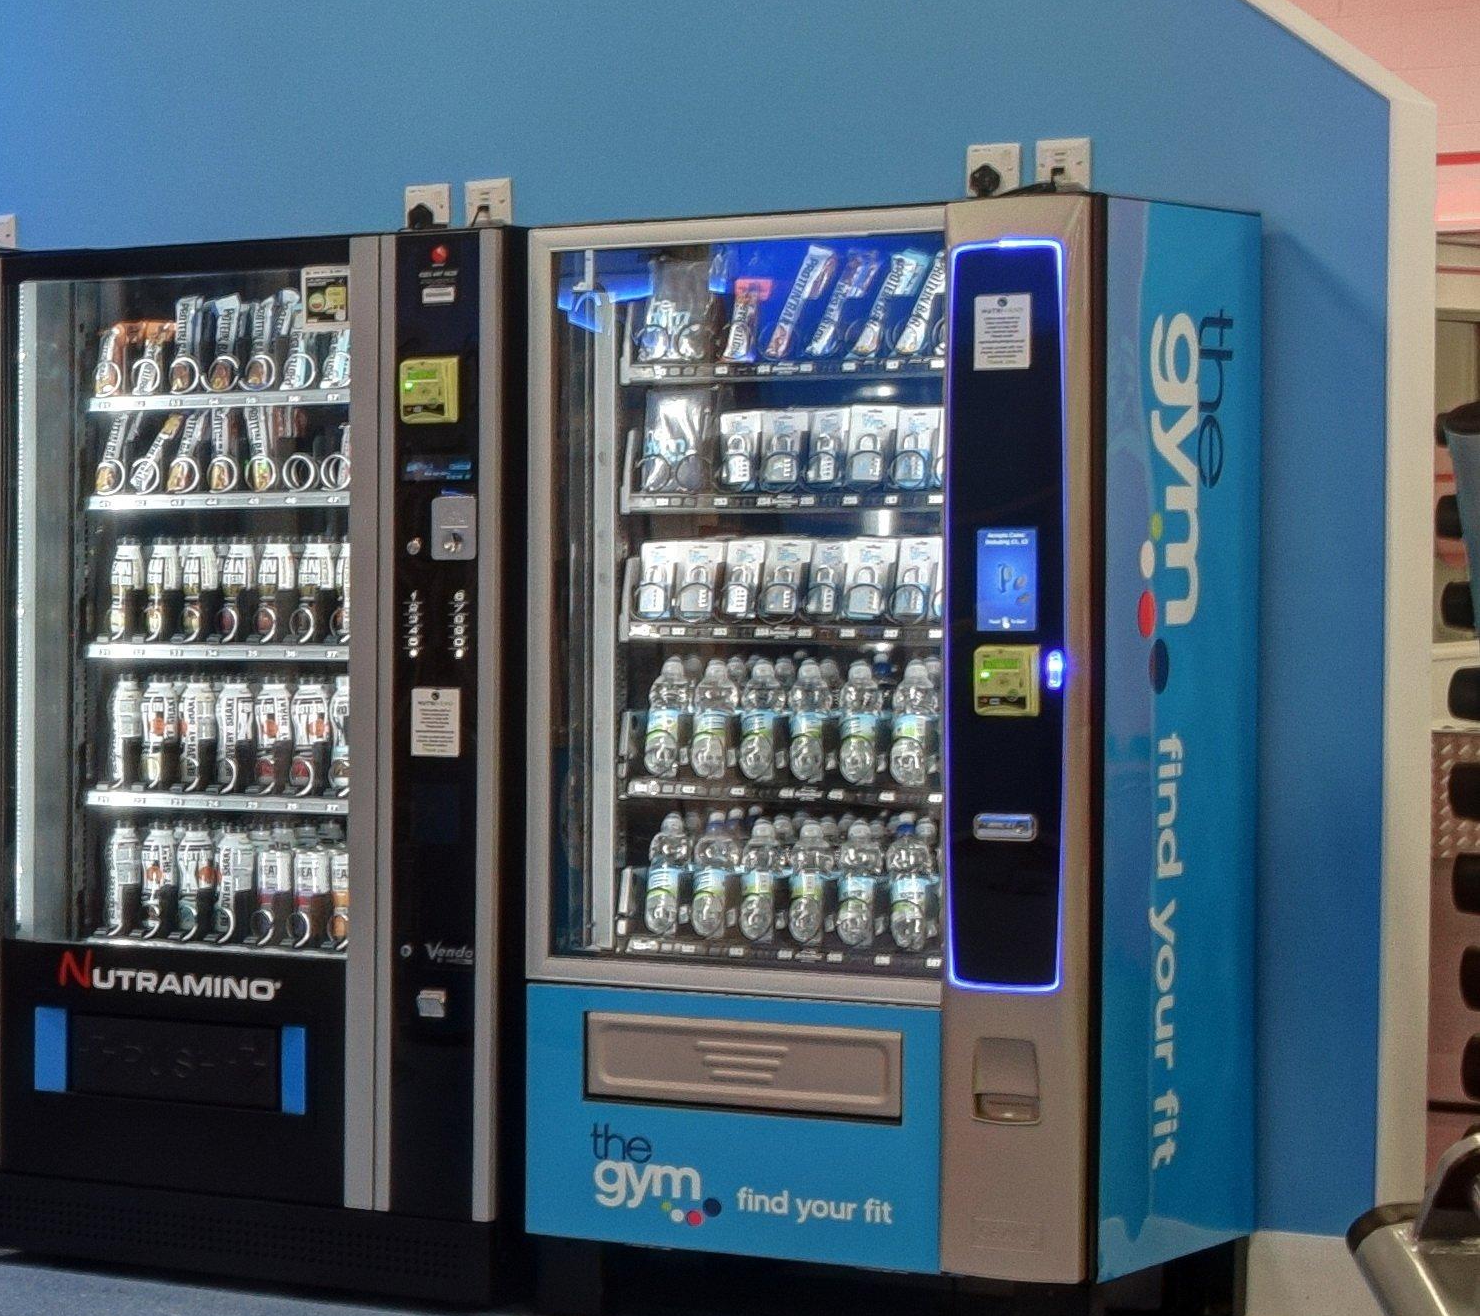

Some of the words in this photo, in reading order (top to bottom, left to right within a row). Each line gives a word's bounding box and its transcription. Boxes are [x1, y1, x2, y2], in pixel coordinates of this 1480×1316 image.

[1199, 309, 1234, 488] the
[1151, 312, 1200, 625] gym
[1156, 733, 1183, 879] find
[60, 949, 275, 1002] NUTRAMINO
[1149, 899, 1178, 1069] your
[591, 1124, 652, 1164] the
[1152, 1088, 1180, 1171] fit
[593, 1161, 701, 1208] gym
[737, 1187, 789, 1215] find
[796, 1195, 857, 1224] your
[864, 1197, 892, 1224] fit
